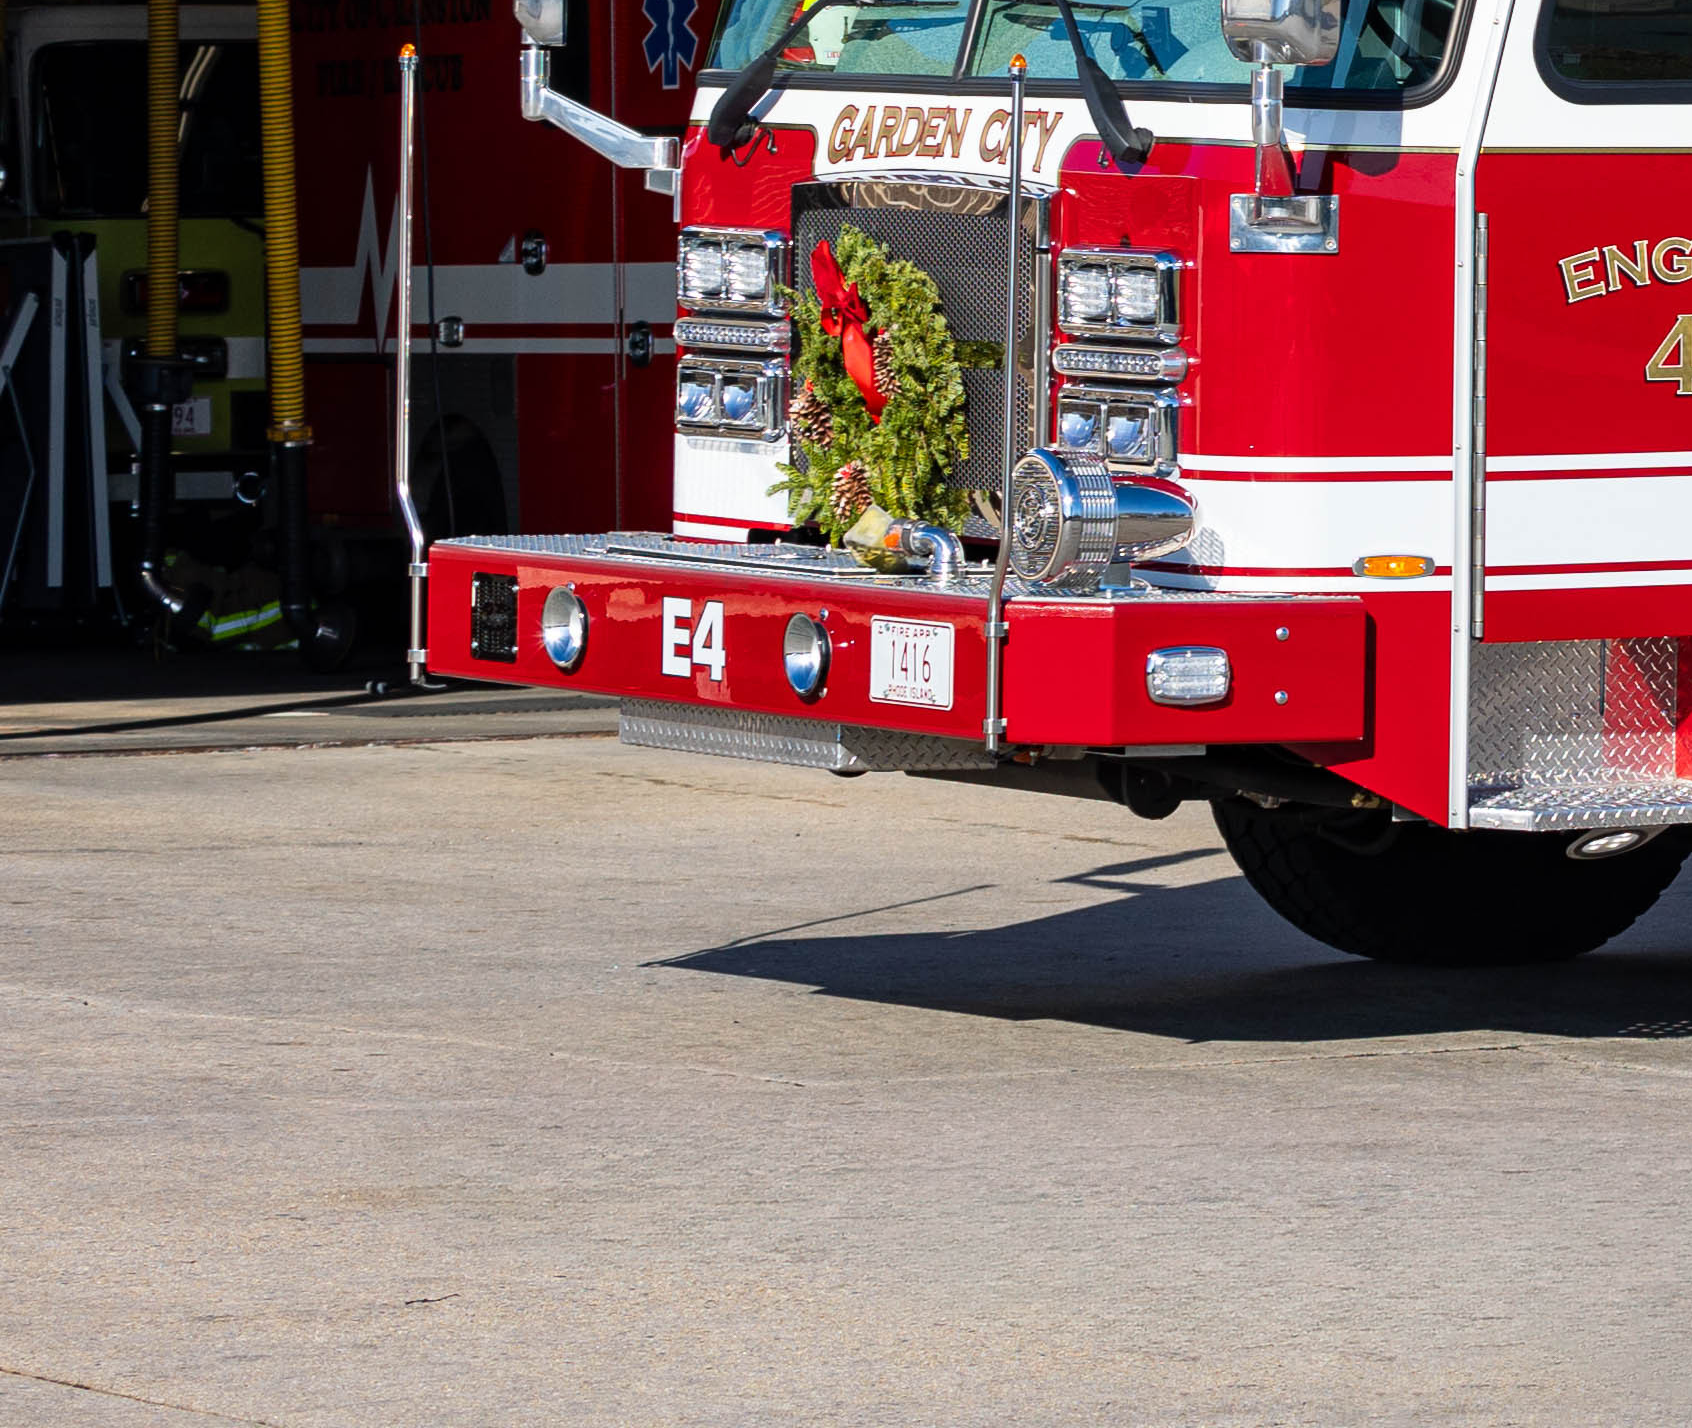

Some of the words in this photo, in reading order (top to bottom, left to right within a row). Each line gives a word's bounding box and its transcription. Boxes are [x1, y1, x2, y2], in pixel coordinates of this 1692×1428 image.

[827, 104, 973, 164] GARDEN
[979, 107, 1063, 173] CITY
[661, 596, 726, 682] E4
[891, 625, 910, 638] FIRE
[892, 639, 931, 682] 1416
